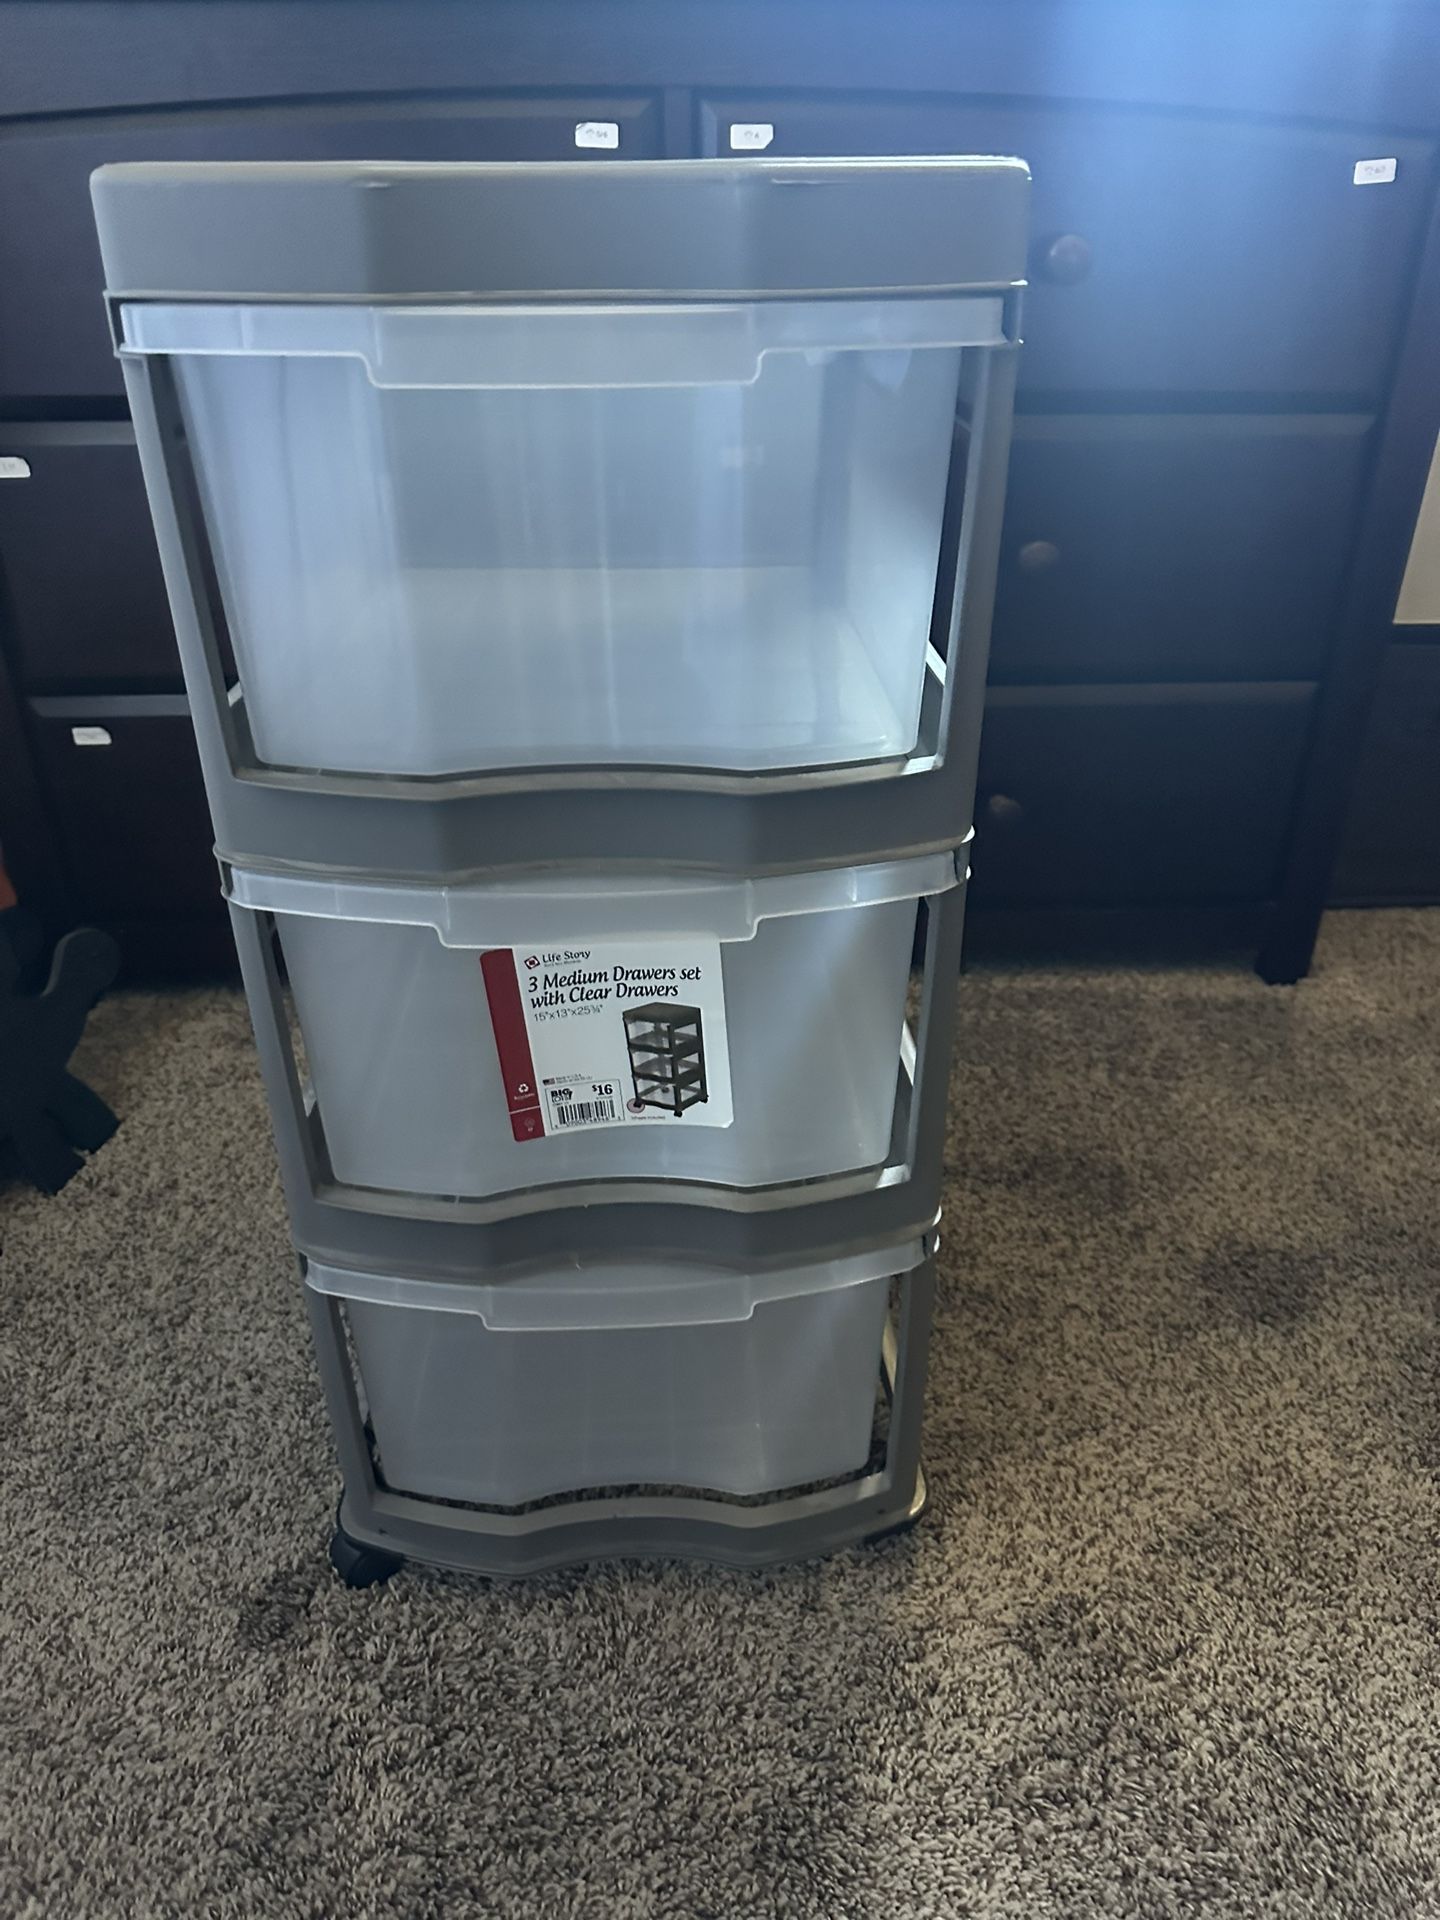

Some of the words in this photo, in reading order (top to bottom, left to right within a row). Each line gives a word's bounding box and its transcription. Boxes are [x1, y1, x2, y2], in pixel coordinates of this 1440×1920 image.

[542, 953, 561, 964] Life
[563, 950, 591, 960] Story
[528, 976, 538, 992] 3
[543, 969, 608, 989] Medium
[613, 965, 676, 981] Drawers
[679, 966, 702, 980] set
[530, 990, 566, 1009] with
[568, 986, 612, 1002] Clear
[616, 982, 679, 998] Drawers
[592, 1084, 613, 1096] $16
